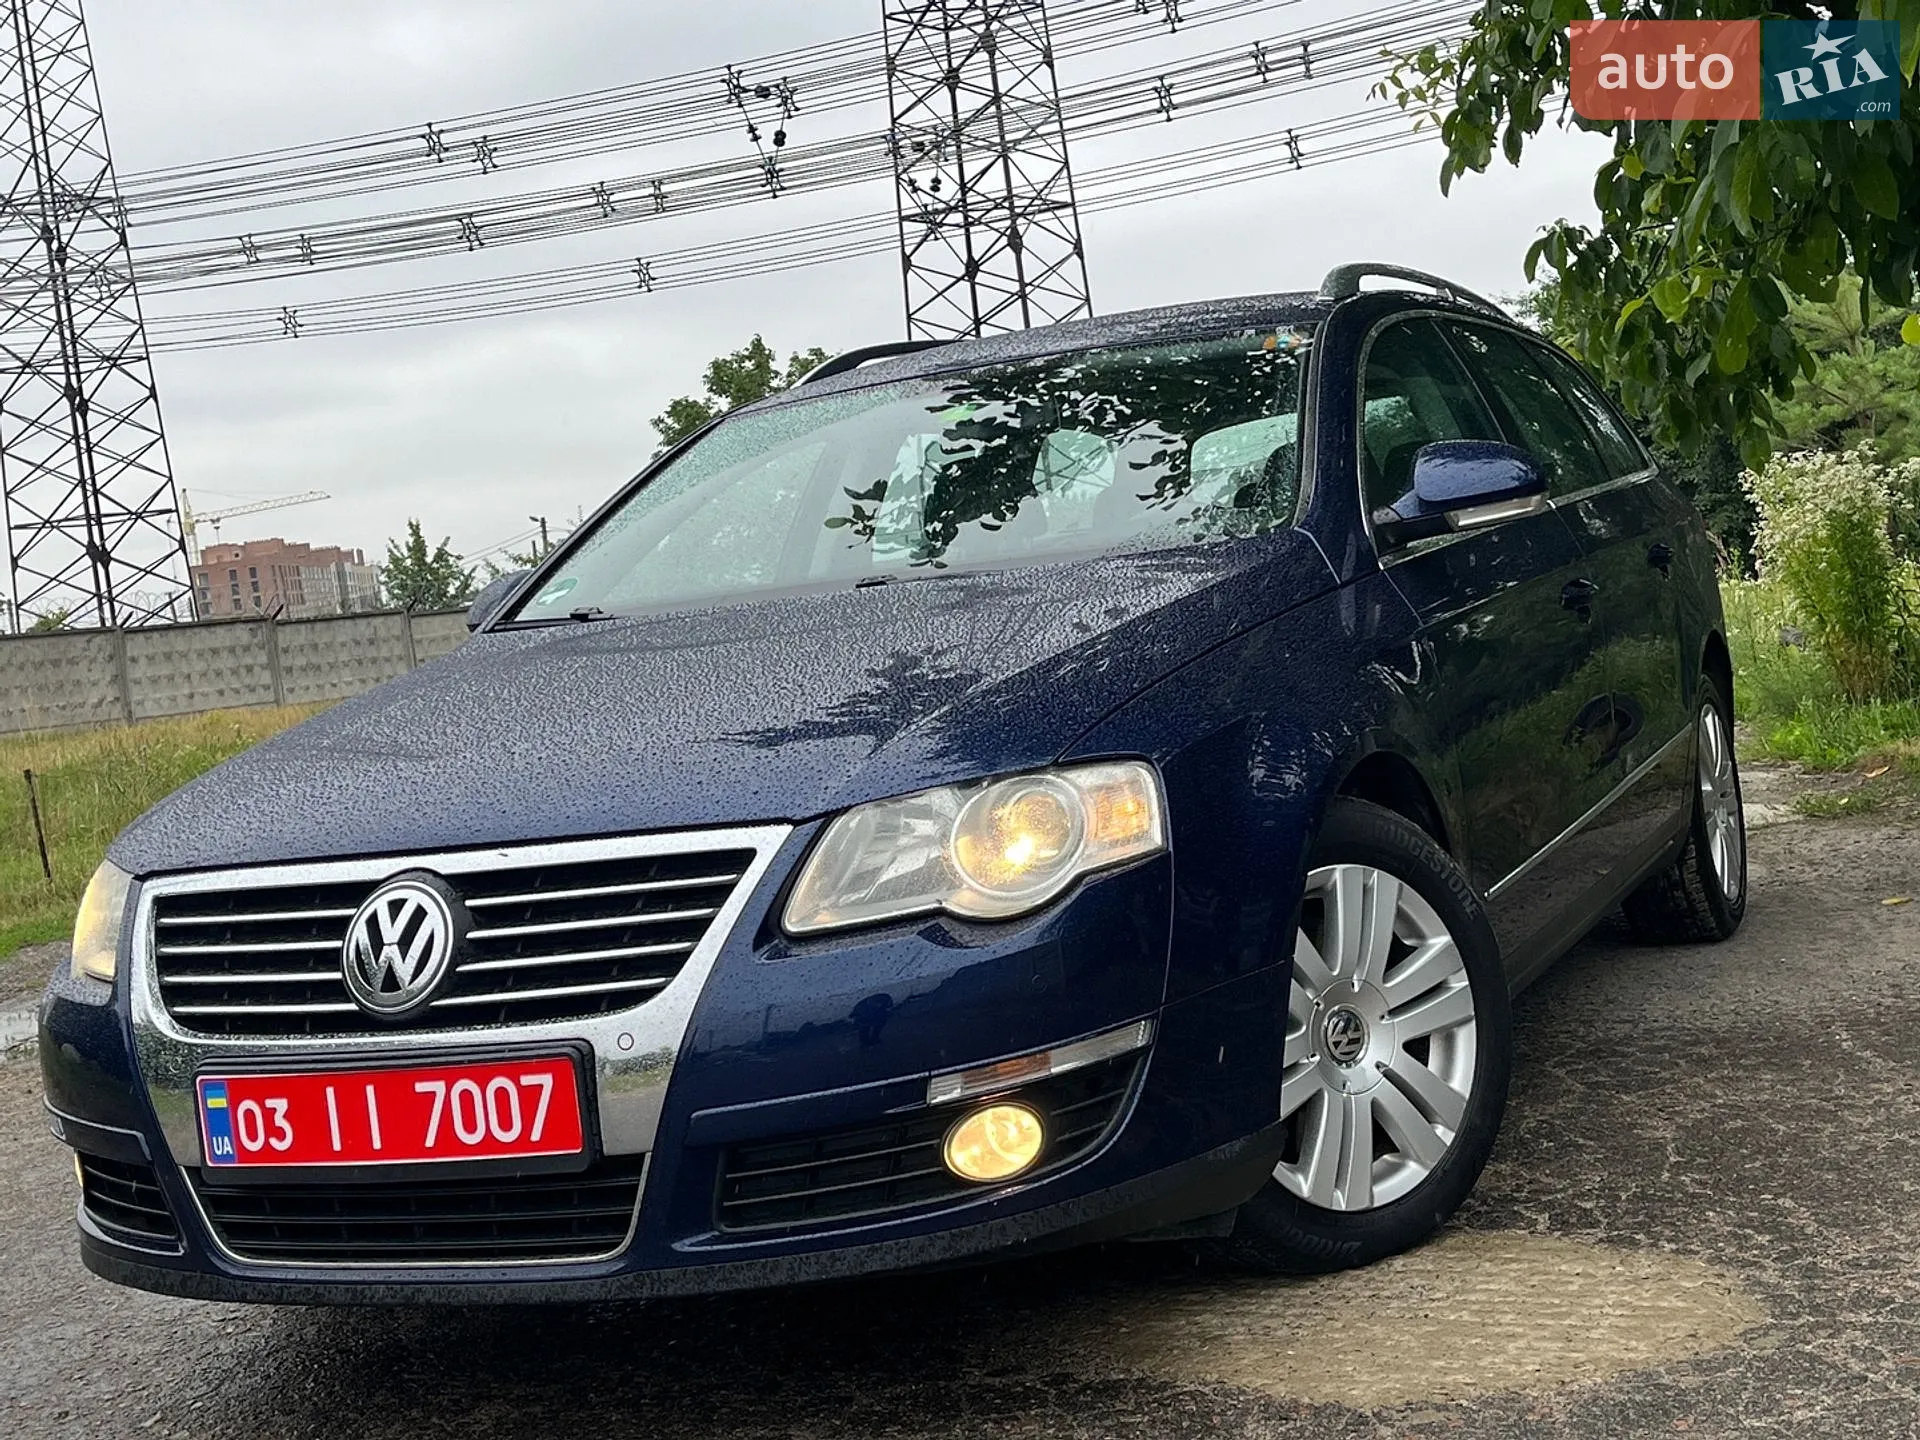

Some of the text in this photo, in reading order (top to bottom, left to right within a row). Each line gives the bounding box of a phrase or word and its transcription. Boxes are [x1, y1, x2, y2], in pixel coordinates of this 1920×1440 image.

[1362, 815, 1481, 920] RIDGESTONE
[212, 1135, 233, 1156] UA
[236, 1097, 293, 1152] 03
[414, 1072, 553, 1148] 7007
